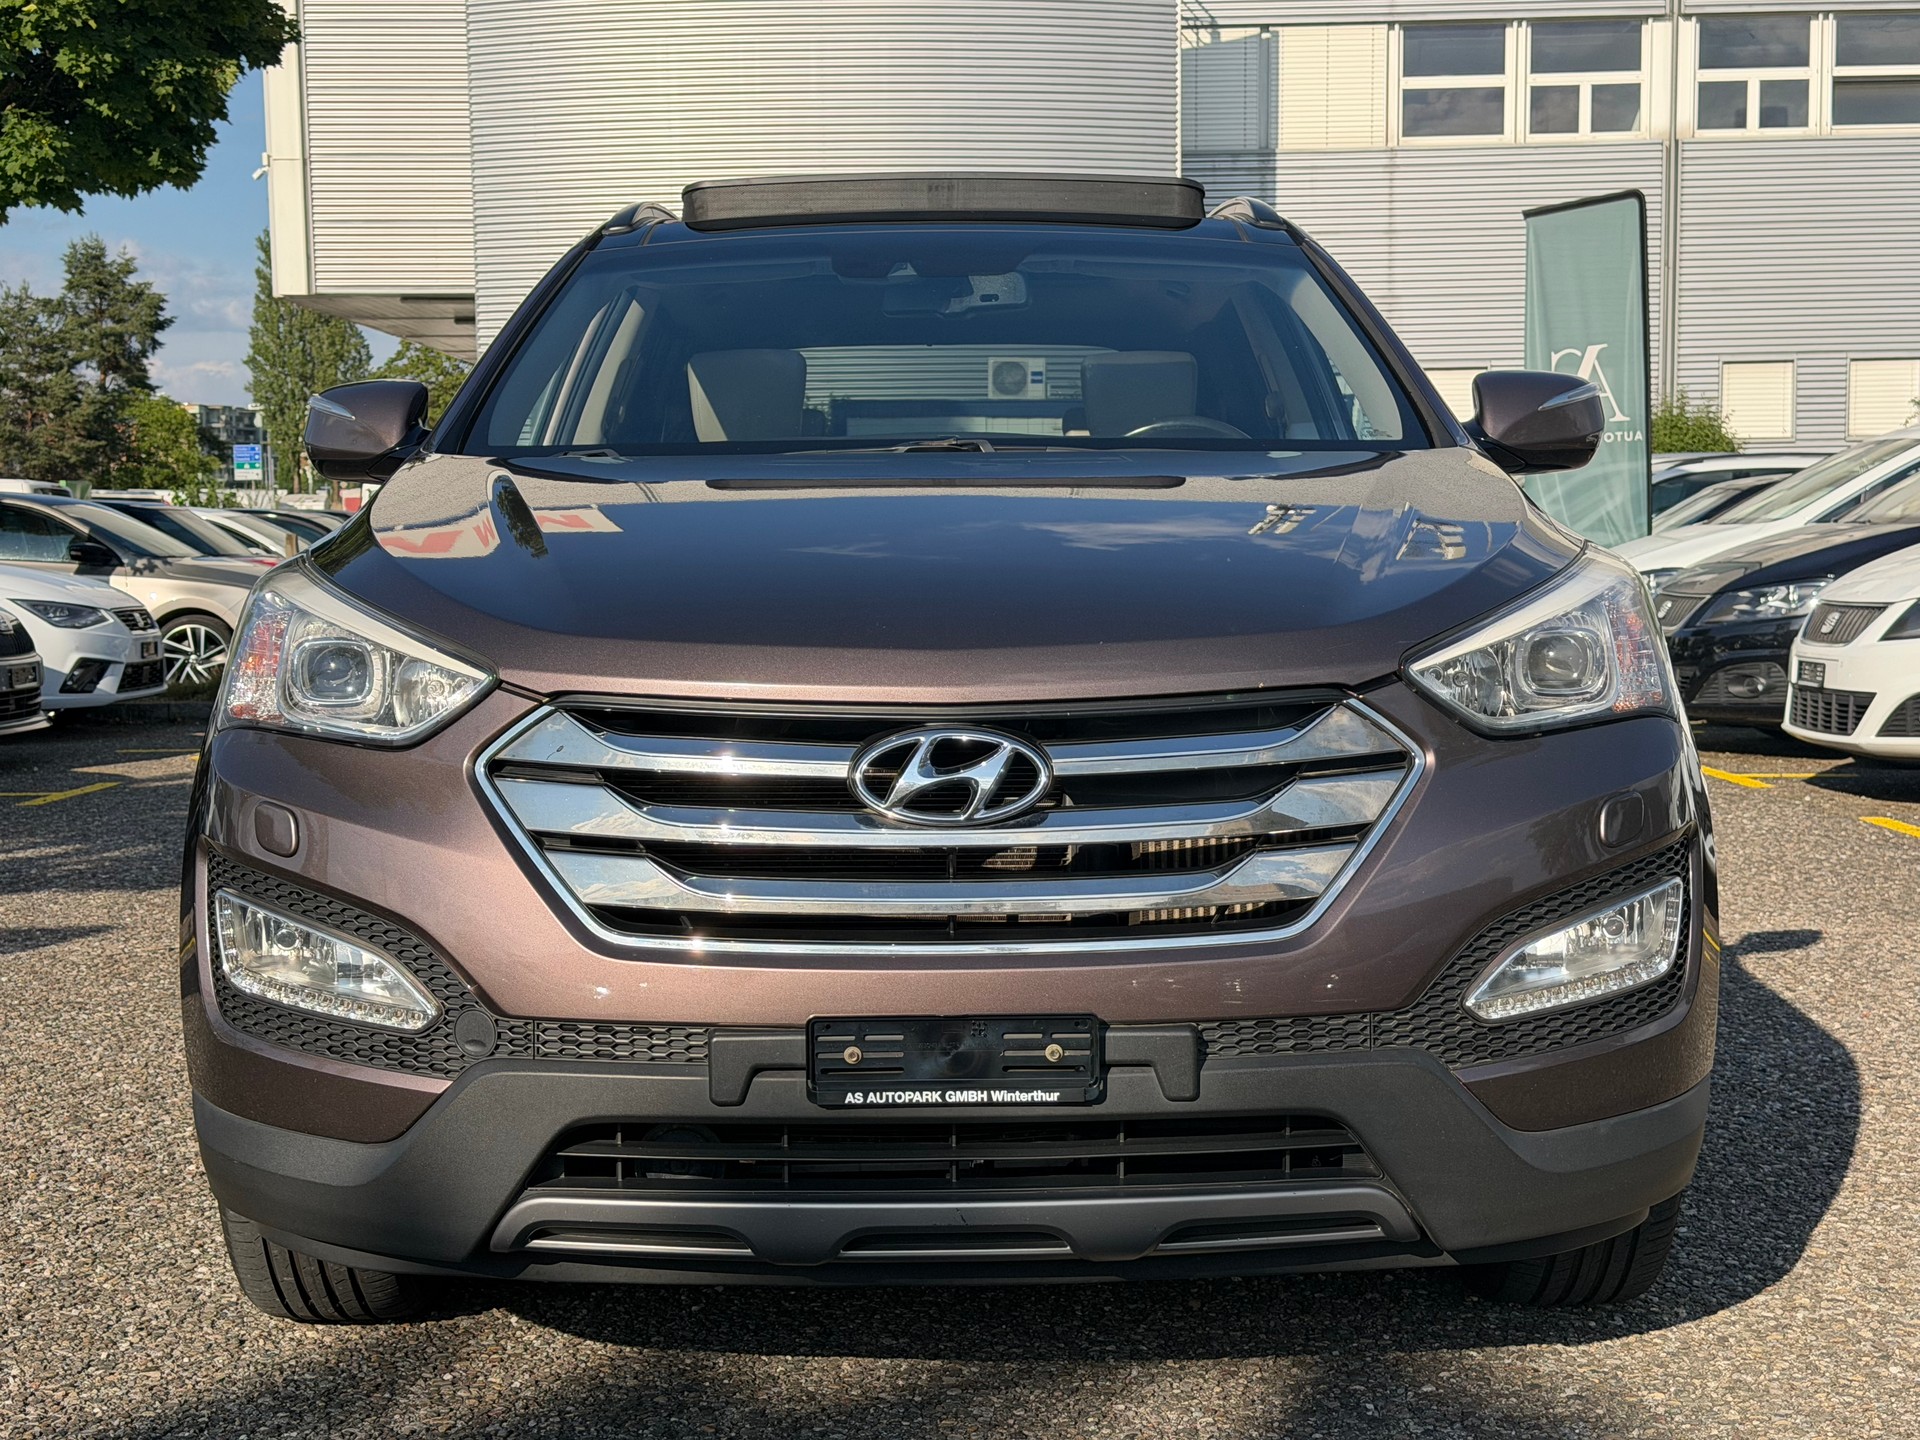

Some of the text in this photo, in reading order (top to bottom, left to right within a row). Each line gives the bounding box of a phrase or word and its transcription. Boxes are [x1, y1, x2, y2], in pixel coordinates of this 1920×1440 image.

[844, 1089, 1061, 1104] AS AUTOPARK GMBH Winterthur
